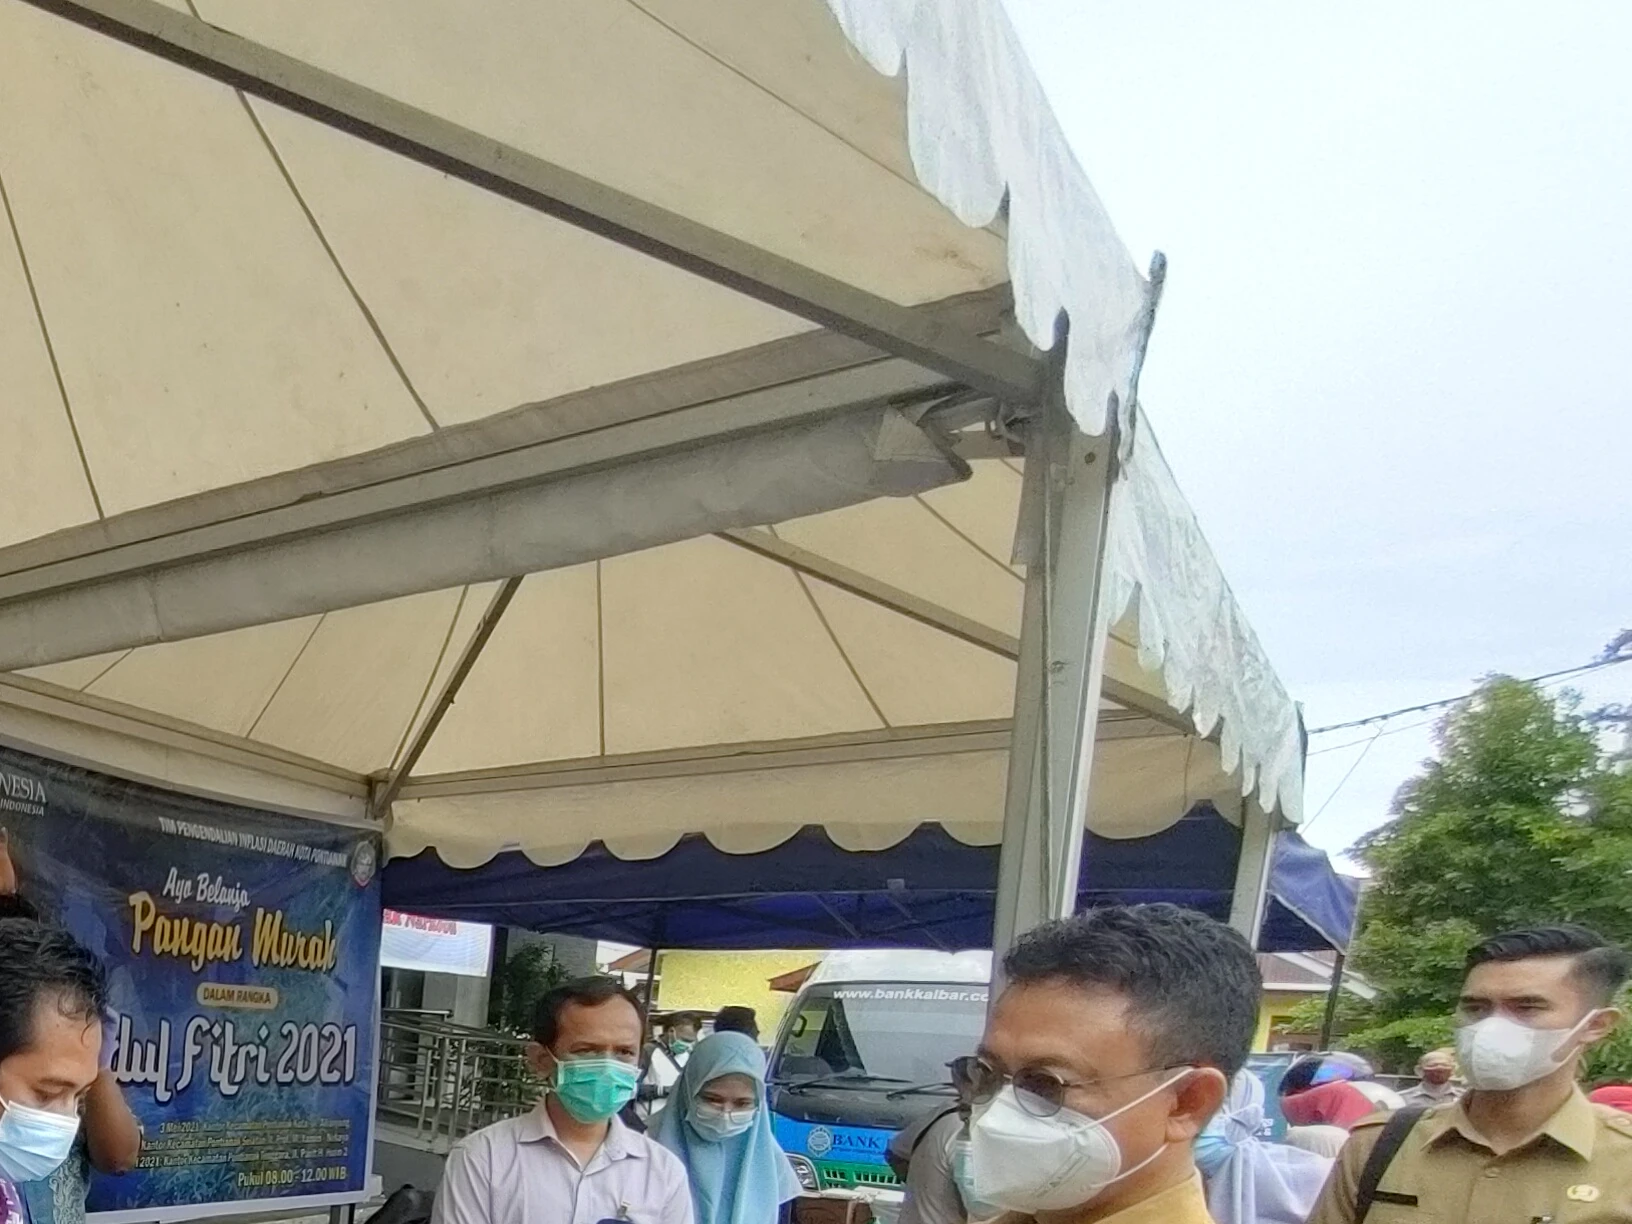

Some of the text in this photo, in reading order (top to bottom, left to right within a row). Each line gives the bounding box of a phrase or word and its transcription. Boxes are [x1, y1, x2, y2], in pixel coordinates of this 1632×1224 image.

[0, 799, 44, 816] INDONESIA
[158, 816, 177, 835] TIM
[178, 821, 238, 846] PENGENDALIAN
[239, 833, 268, 853] INFLASI
[268, 838, 294, 858] DAERAH
[163, 867, 250, 913] Ayo Belanja
[129, 890, 338, 972] Pangan Murah
[203, 988, 271, 1004] DALAM RANGKA
[176, 1016, 270, 1095] Fitri
[276, 1023, 356, 1083] 2021
[832, 1135, 881, 1149] BANK
[238, 1172, 263, 1186] Pukul
[266, 1169, 293, 1184] 08.00
[301, 1167, 327, 1182] 12.00
[328, 1166, 347, 1180] WIB
